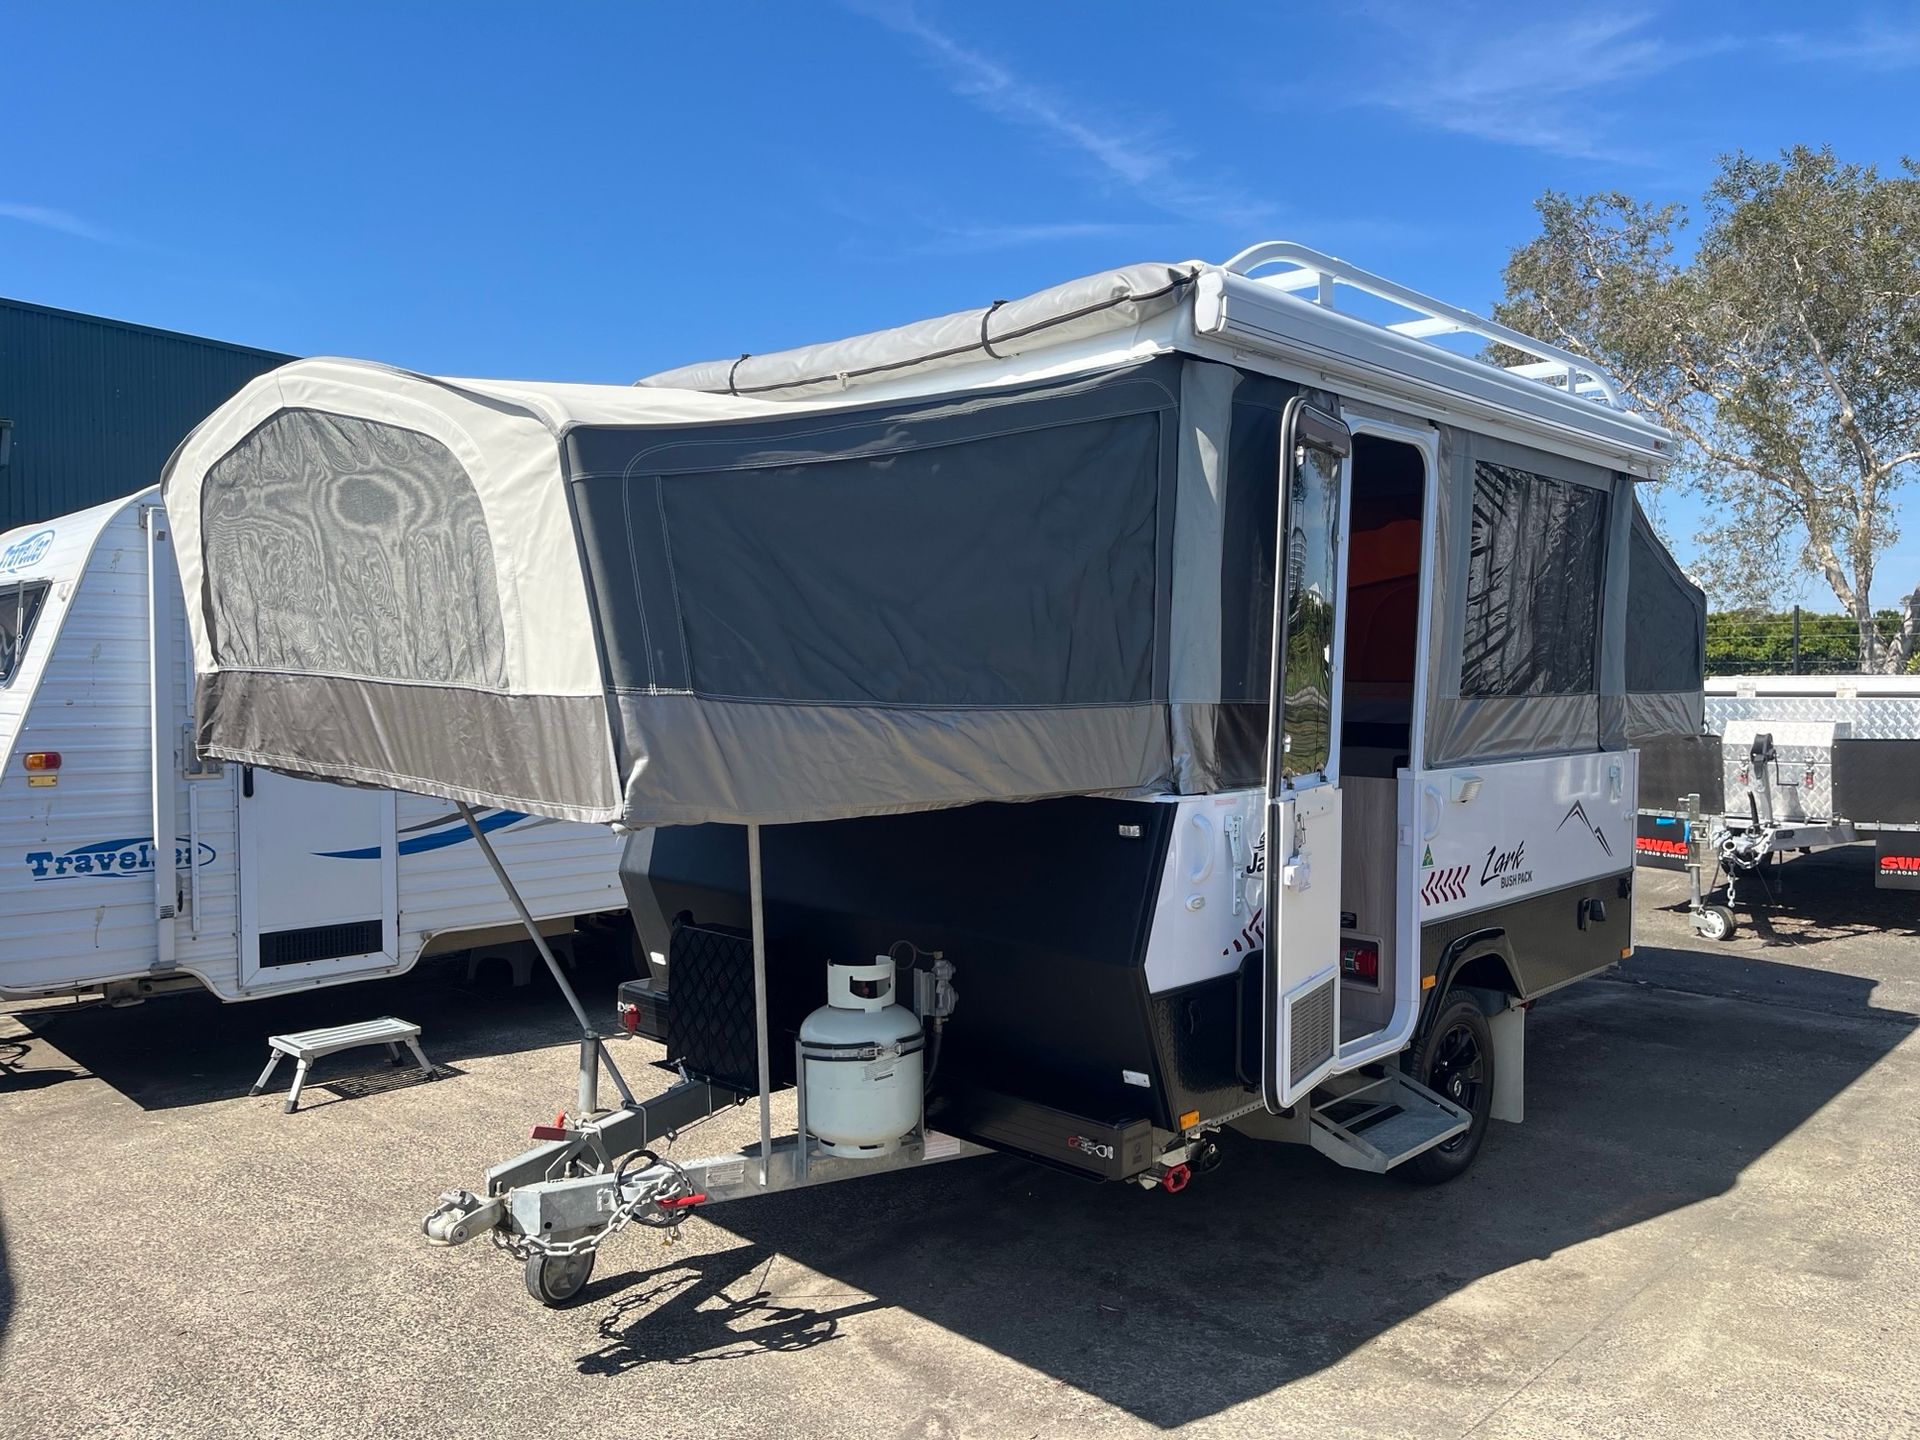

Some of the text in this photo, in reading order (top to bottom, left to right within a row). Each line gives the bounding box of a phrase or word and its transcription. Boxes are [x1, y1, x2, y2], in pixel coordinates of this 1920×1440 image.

[1635, 837, 1688, 855] SWAG
[26, 845, 202, 877] Travelr
[1480, 840, 1525, 887] Lark
[1880, 856, 1920, 870] SW
[1501, 870, 1533, 889] BUSH PACK
